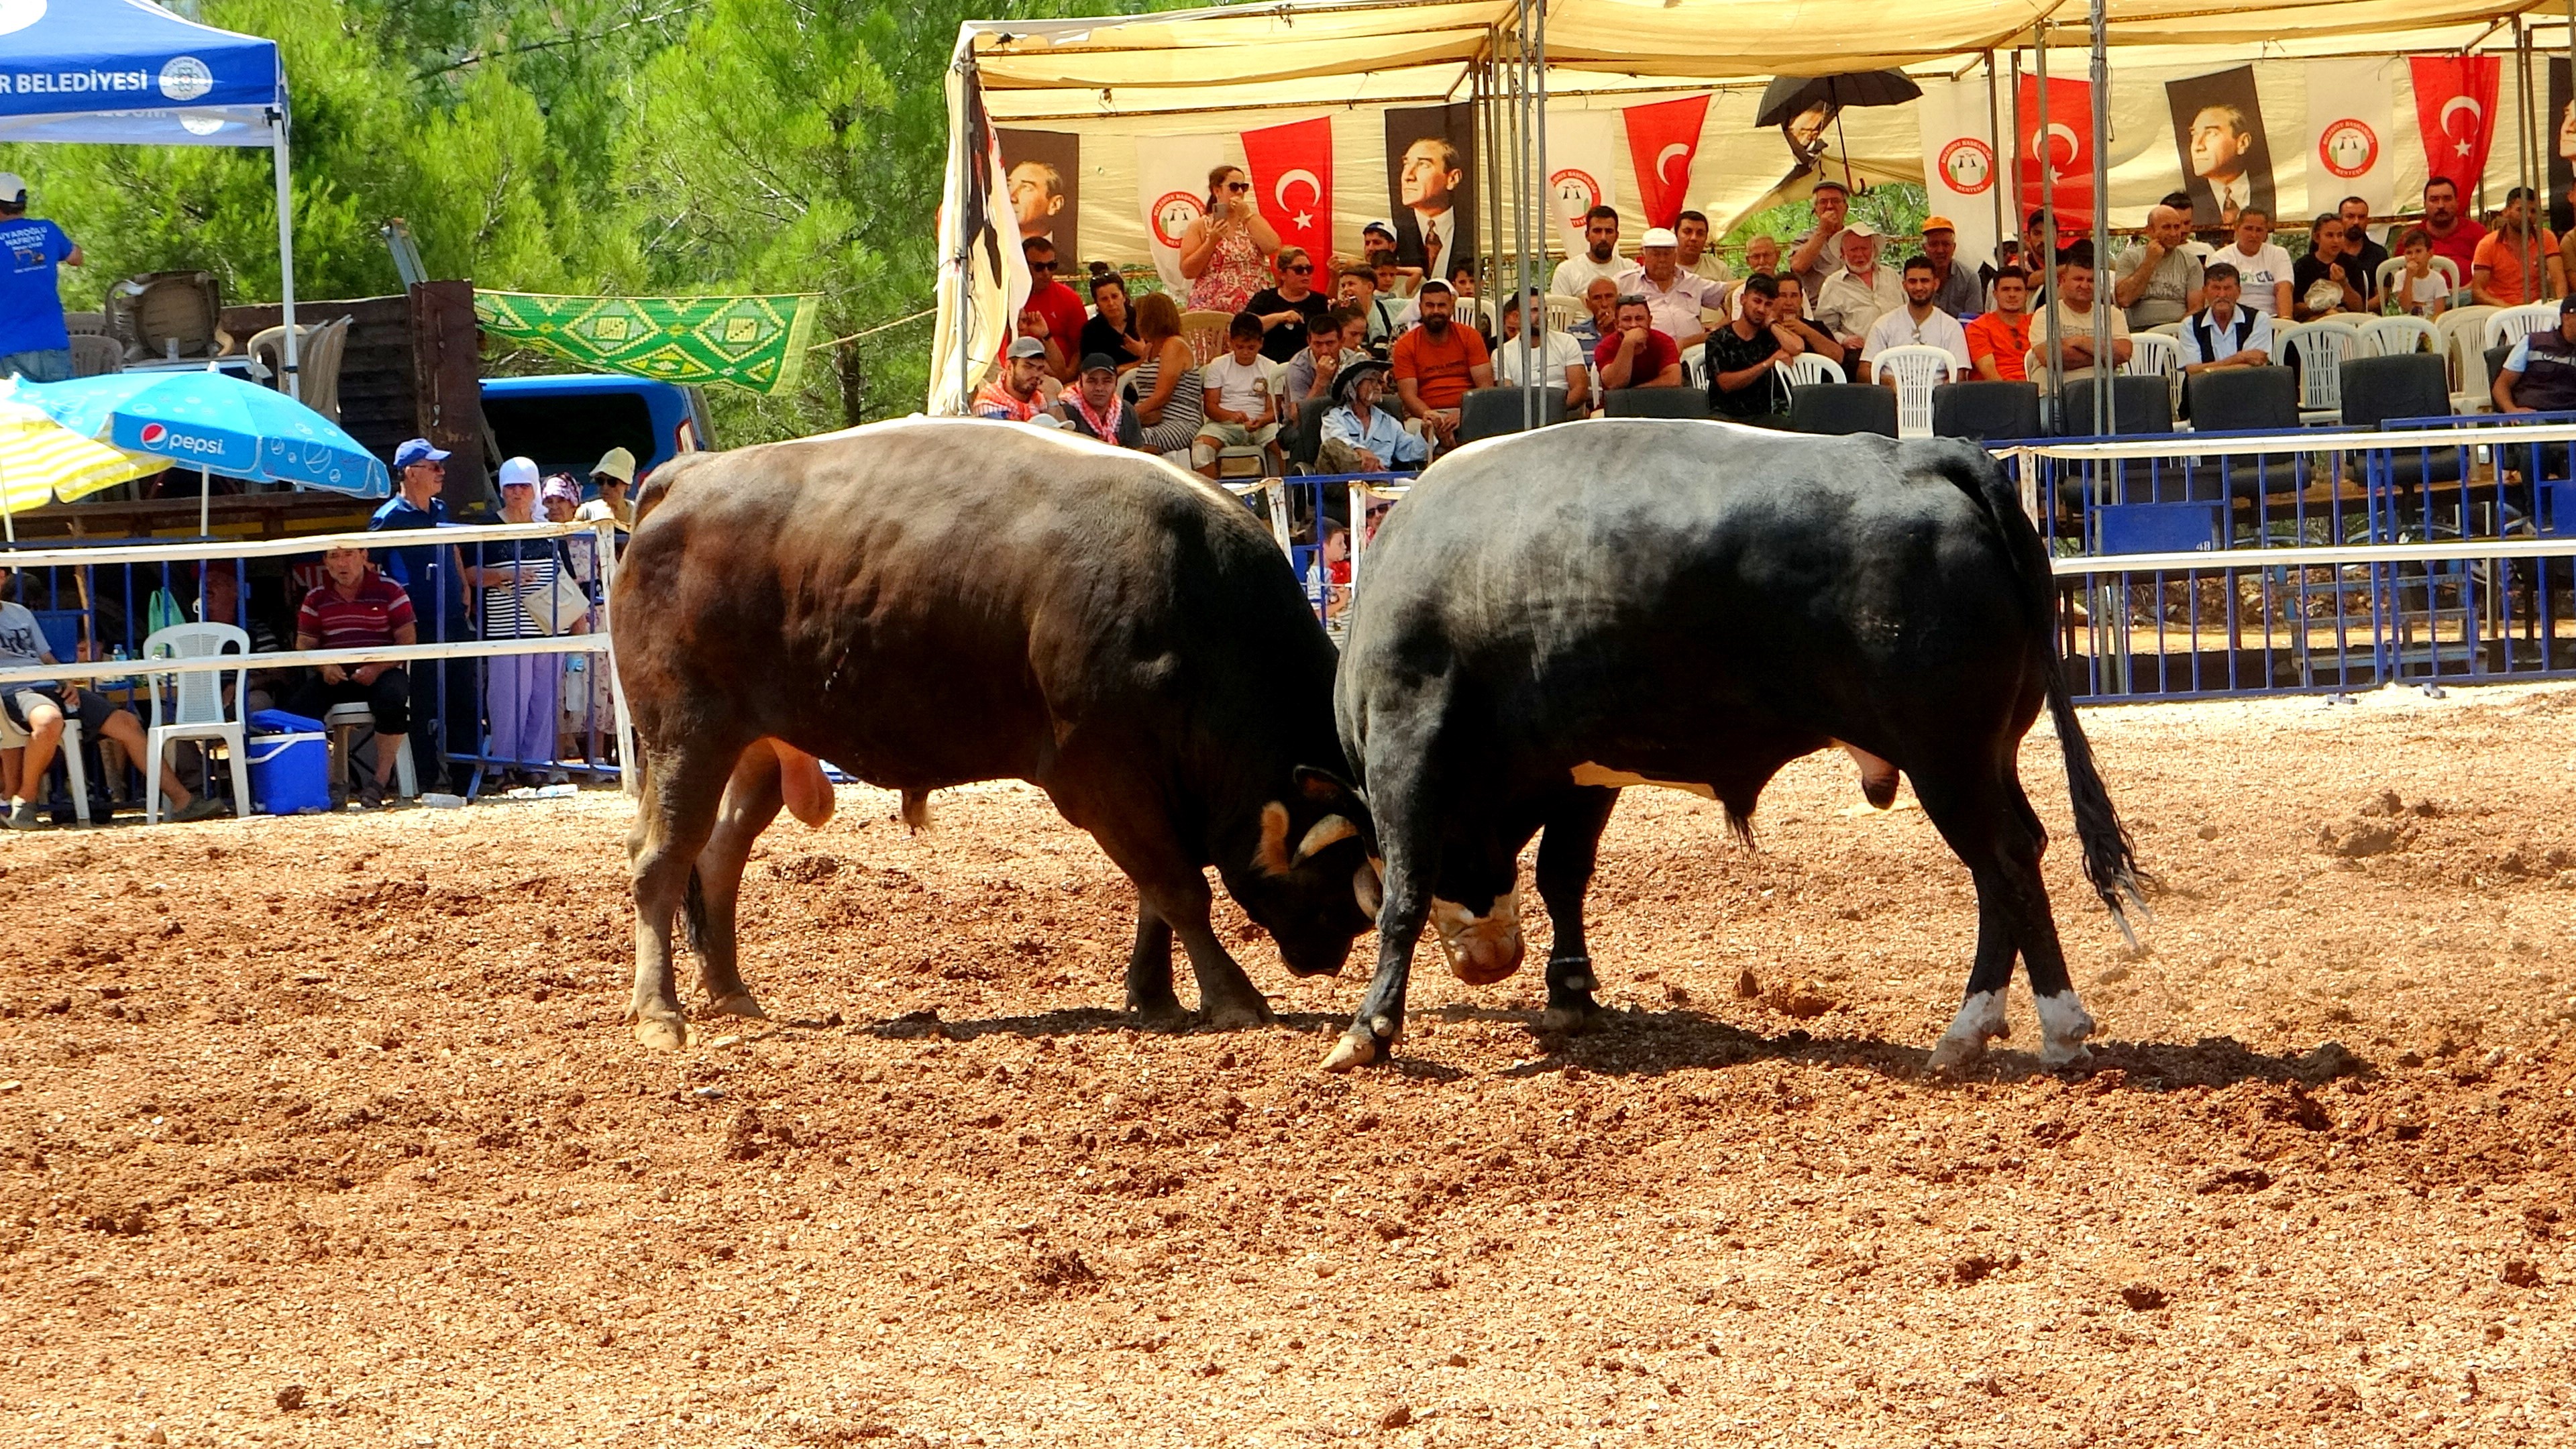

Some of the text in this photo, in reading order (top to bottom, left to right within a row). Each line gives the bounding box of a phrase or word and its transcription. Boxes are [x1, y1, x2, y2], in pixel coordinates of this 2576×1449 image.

[16, 69, 148, 93] BELEDİYESİ
[168, 433, 223, 455] pepsi
[2196, 541, 2211, 551] 48
